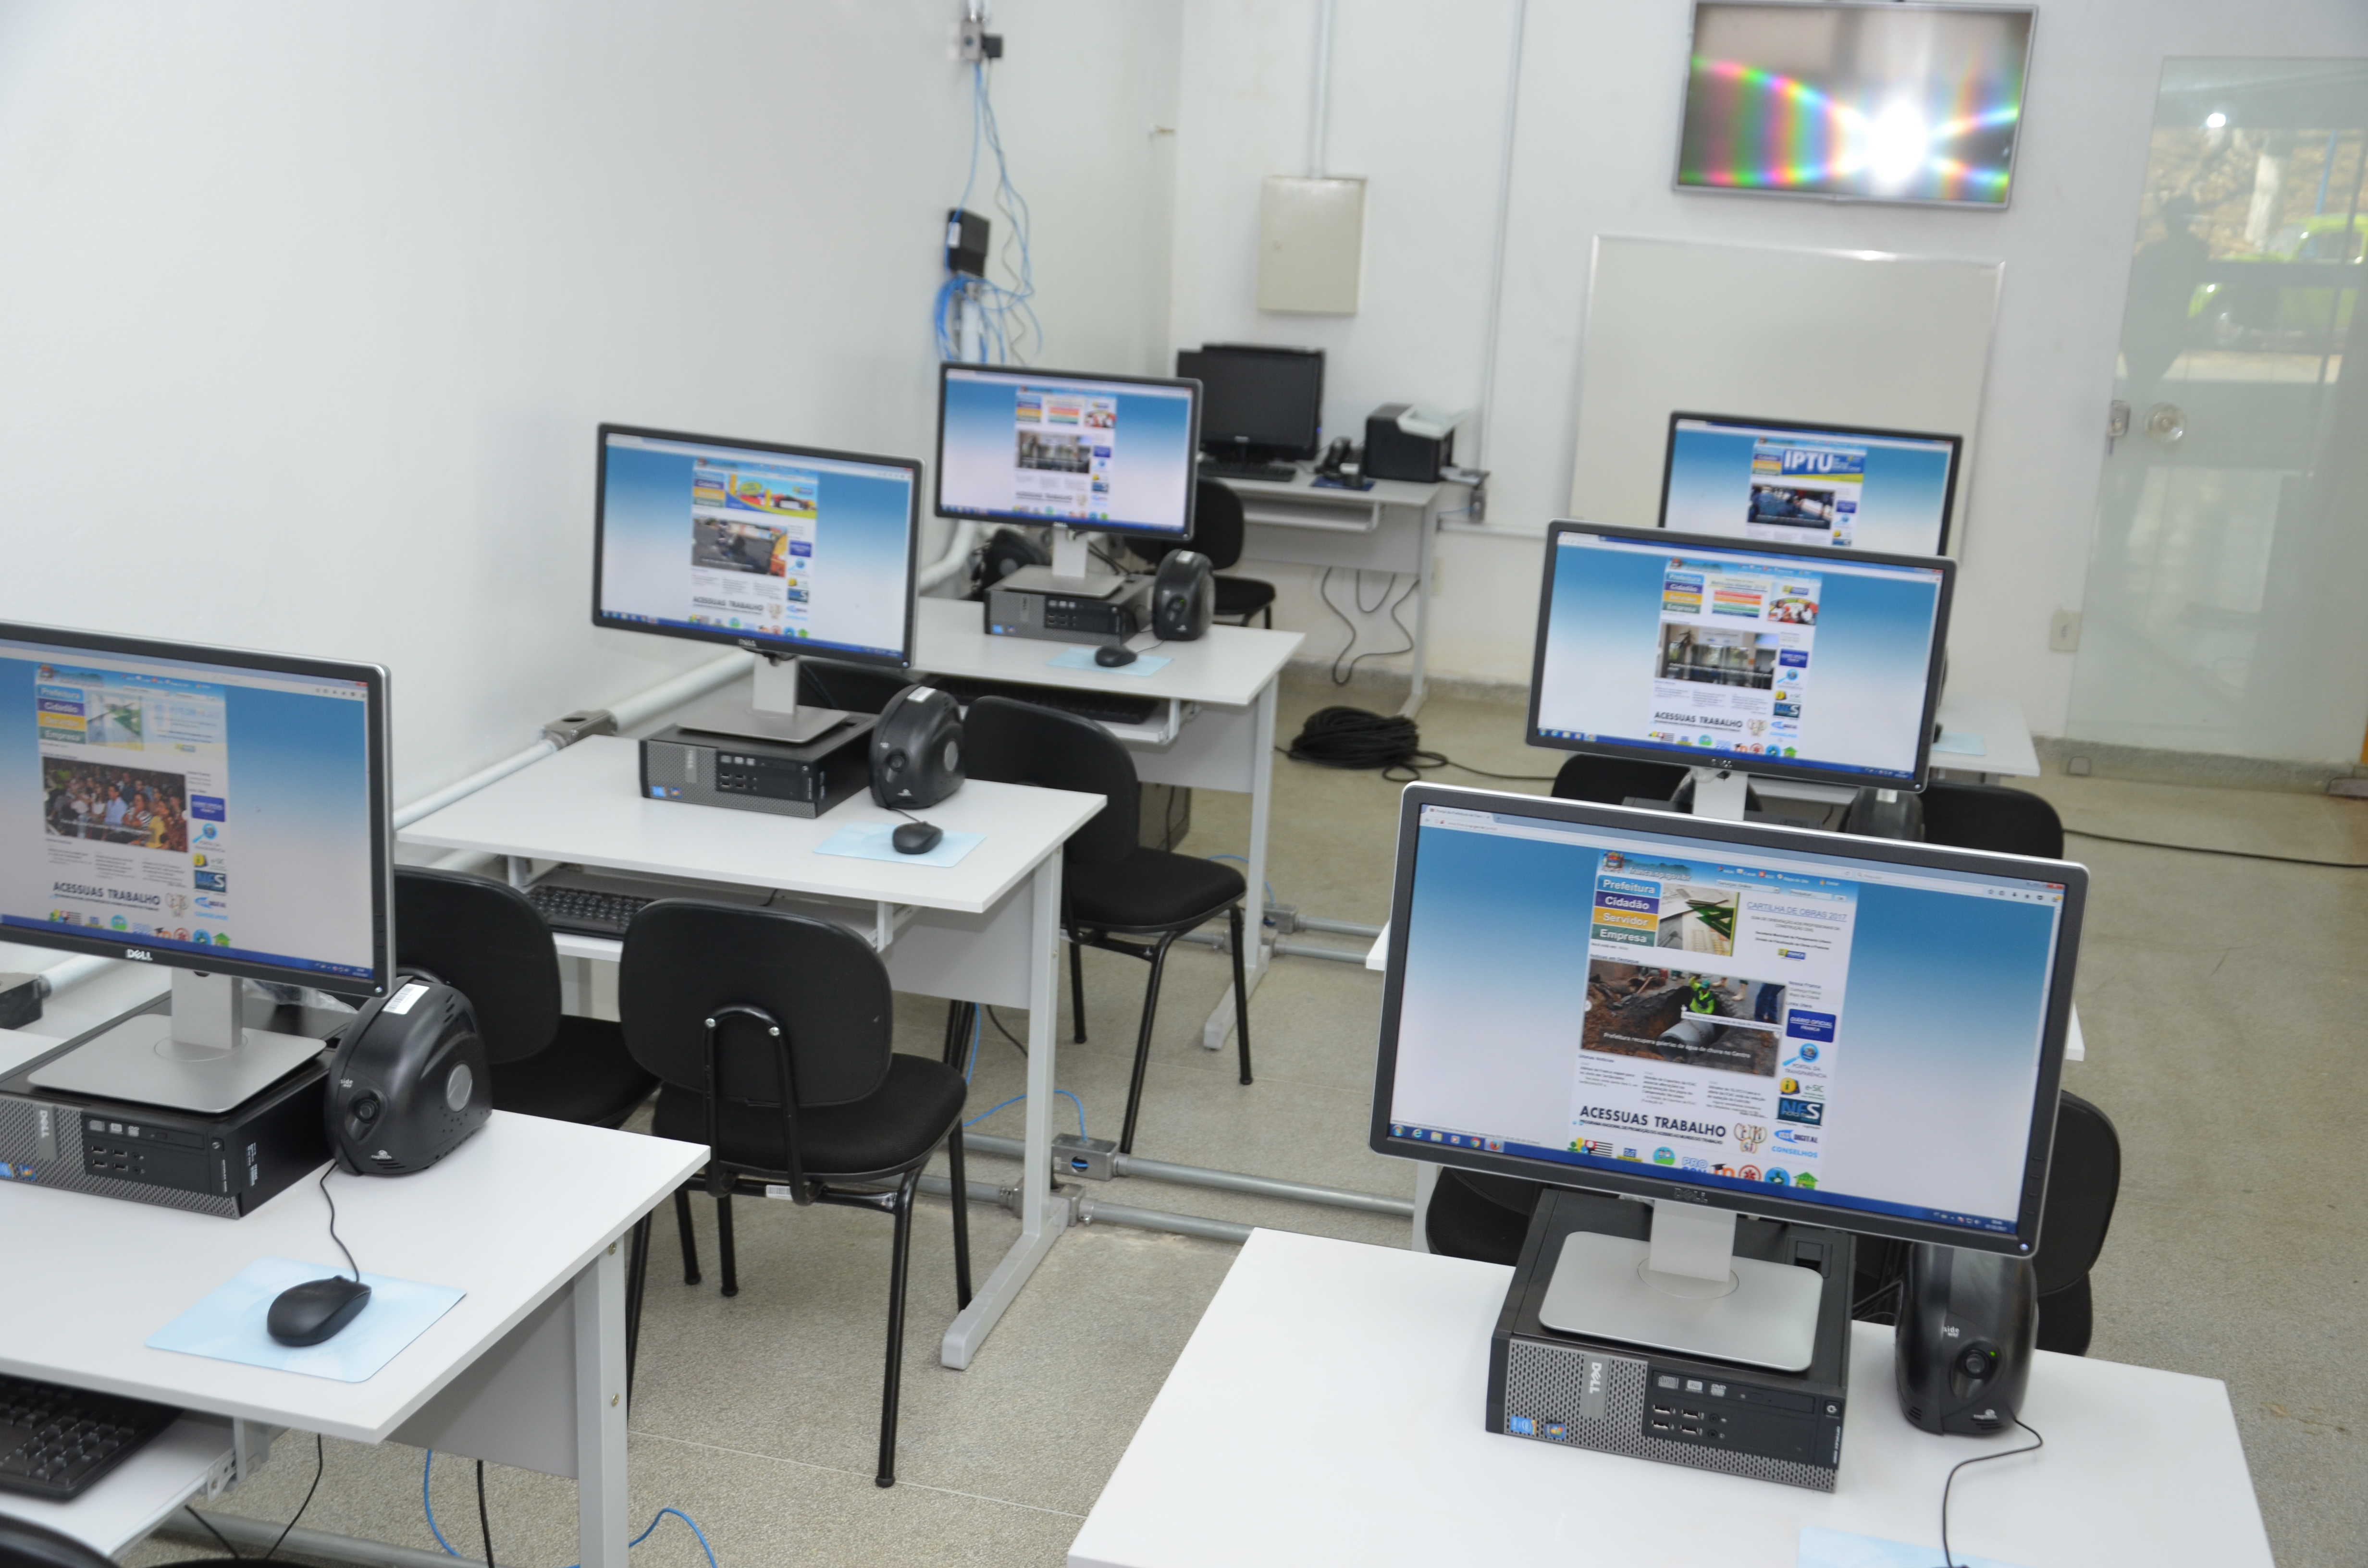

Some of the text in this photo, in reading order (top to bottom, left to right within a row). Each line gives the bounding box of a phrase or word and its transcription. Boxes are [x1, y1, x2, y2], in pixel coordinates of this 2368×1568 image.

[1784, 449, 1834, 473] IPTU
[729, 600, 764, 612] TRABALHO
[1654, 711, 1743, 728] ACESSUAS TRABALHO
[53, 882, 104, 897] ACESSUAS
[108, 889, 160, 905] TRABALHO
[1603, 878, 1655, 894] Prefeitura
[1604, 895, 1650, 910] Cidadão
[1746, 901, 1783, 912] CARTILHA
[1799, 908, 1827, 918] OBRAS
[1828, 912, 1847, 920] 2017
[1602, 912, 1649, 927] Servidor
[1599, 928, 1648, 944] Empresa
[126, 949, 153, 961] DELL
[40, 1110, 49, 1138] DELL
[1579, 1105, 1726, 1138] ACESSUAS TRABALHO
[1793, 1134, 1818, 1143] DIGITAL
[1771, 1145, 1818, 1158] CONSELHOS
[1675, 1188, 1708, 1203] DELL
[1943, 1325, 1960, 1334] side
[1589, 1361, 1603, 1394] DELL
